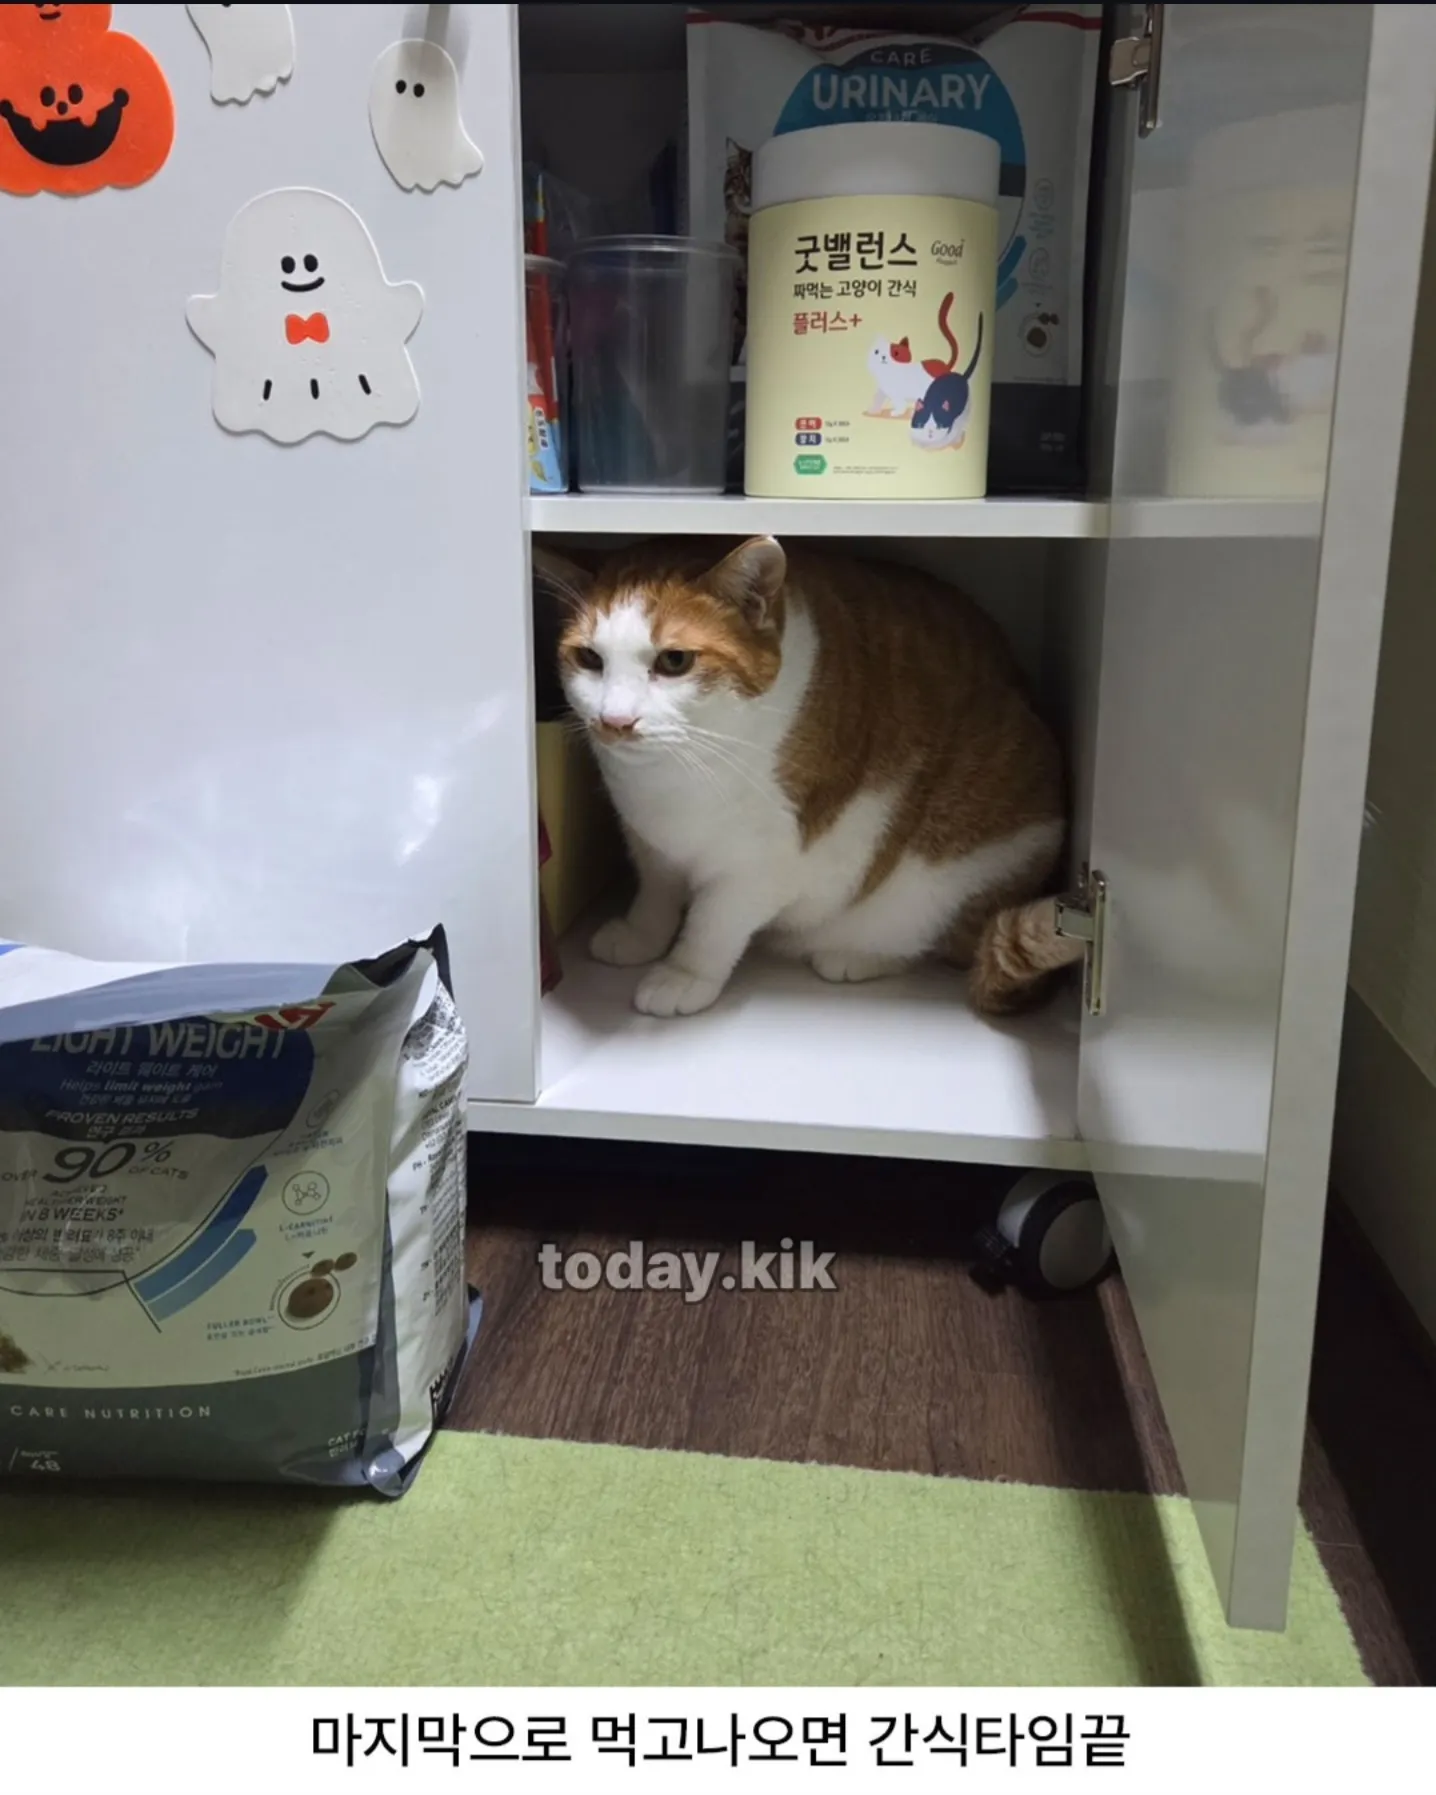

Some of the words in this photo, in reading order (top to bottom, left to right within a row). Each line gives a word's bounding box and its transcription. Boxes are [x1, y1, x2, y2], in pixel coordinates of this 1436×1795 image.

[870, 48, 933, 67] CARE
[812, 72, 992, 111] URINARY
[795, 231, 918, 275] 굿밸런스
[931, 239, 965, 258] Good
[793, 282, 833, 300] 짜먹는
[836, 279, 882, 298] 고양이
[887, 279, 917, 298] 간식
[793, 310, 862, 336] 플러스+
[86, 1061, 132, 1076] 라이트
[60, 1079, 101, 1093] Helps
[104, 1080, 140, 1092] limit
[142, 1080, 191, 1095] weight
[45, 1109, 121, 1126] PROVEN
[122, 1108, 199, 1125] RESULTS
[150, 1168, 190, 1181] CATS
[38, 1208, 49, 1221] 8
[10, 1404, 69, 1419] CARE
[84, 1404, 212, 1420] NUTRITION
